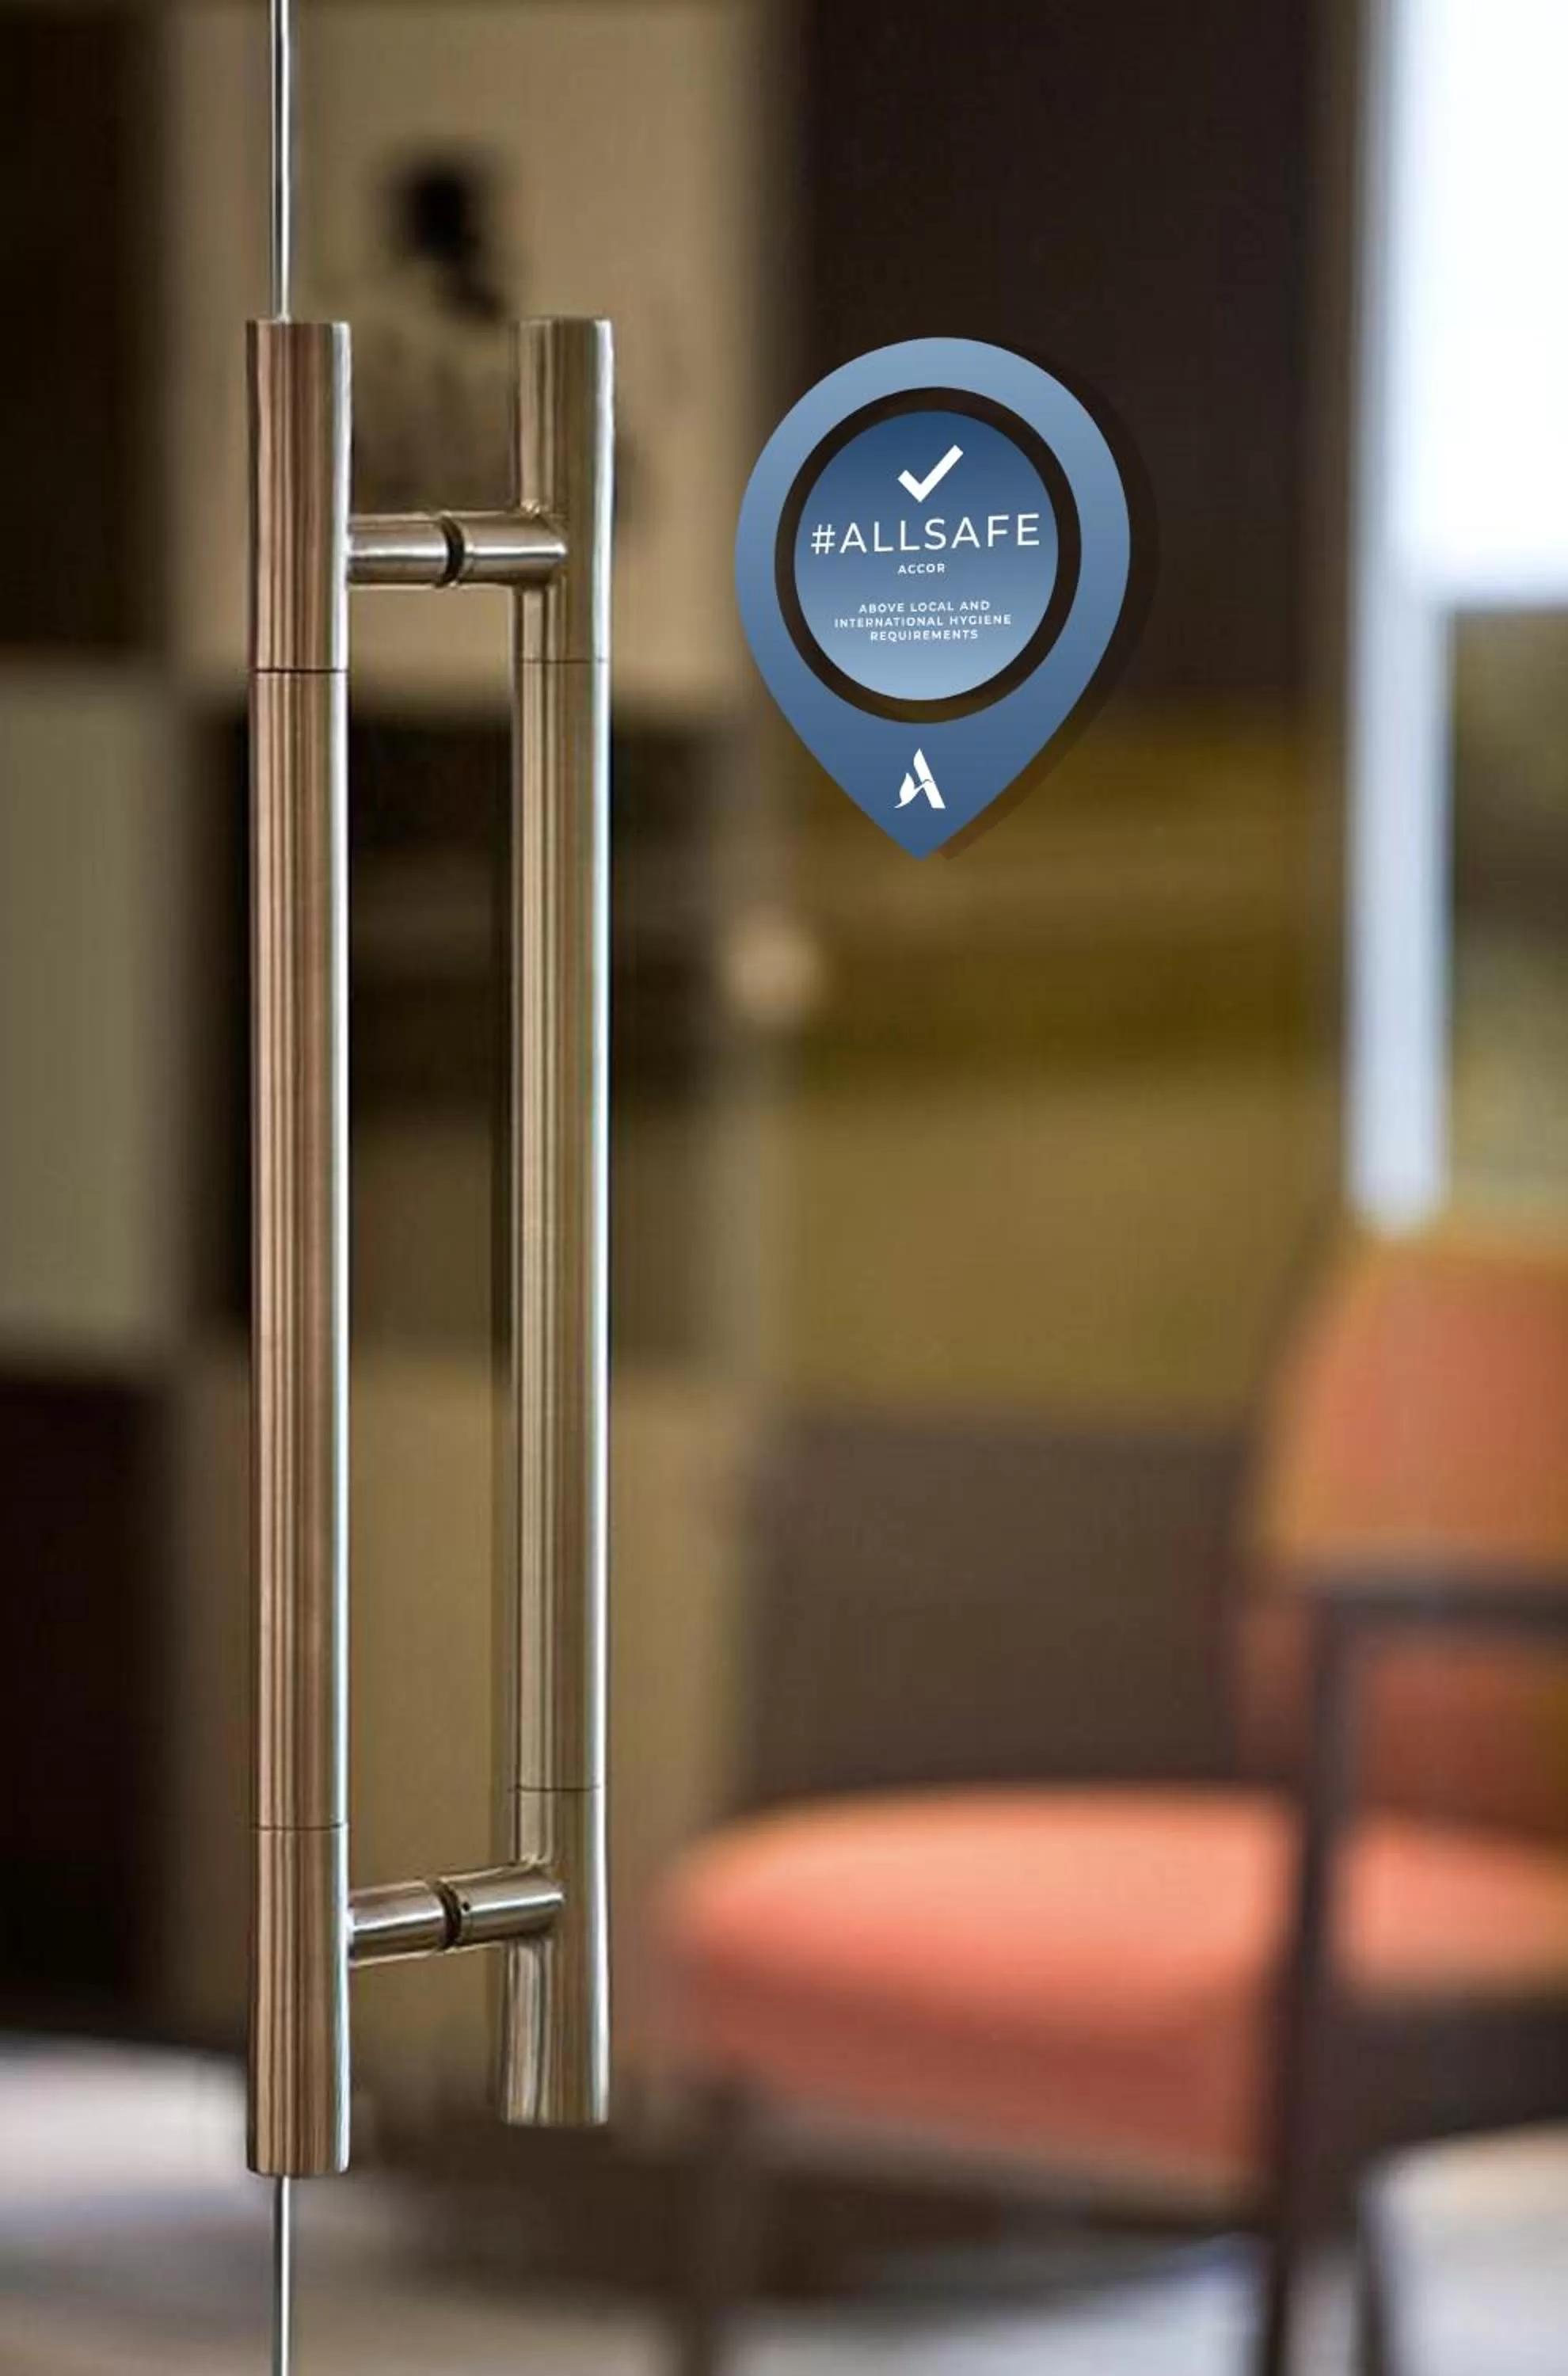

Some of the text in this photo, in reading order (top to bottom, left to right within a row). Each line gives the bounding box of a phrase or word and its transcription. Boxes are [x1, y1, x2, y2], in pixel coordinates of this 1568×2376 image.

[810, 513, 1040, 554] #ALLSAFE
[897, 562, 946, 575] ACCOR
[858, 600, 990, 614] ABOVE LOCAL AND
[834, 614, 1012, 628] INTERNATIONAL HYGIENE
[870, 629, 979, 642] REQUIREMENTS
